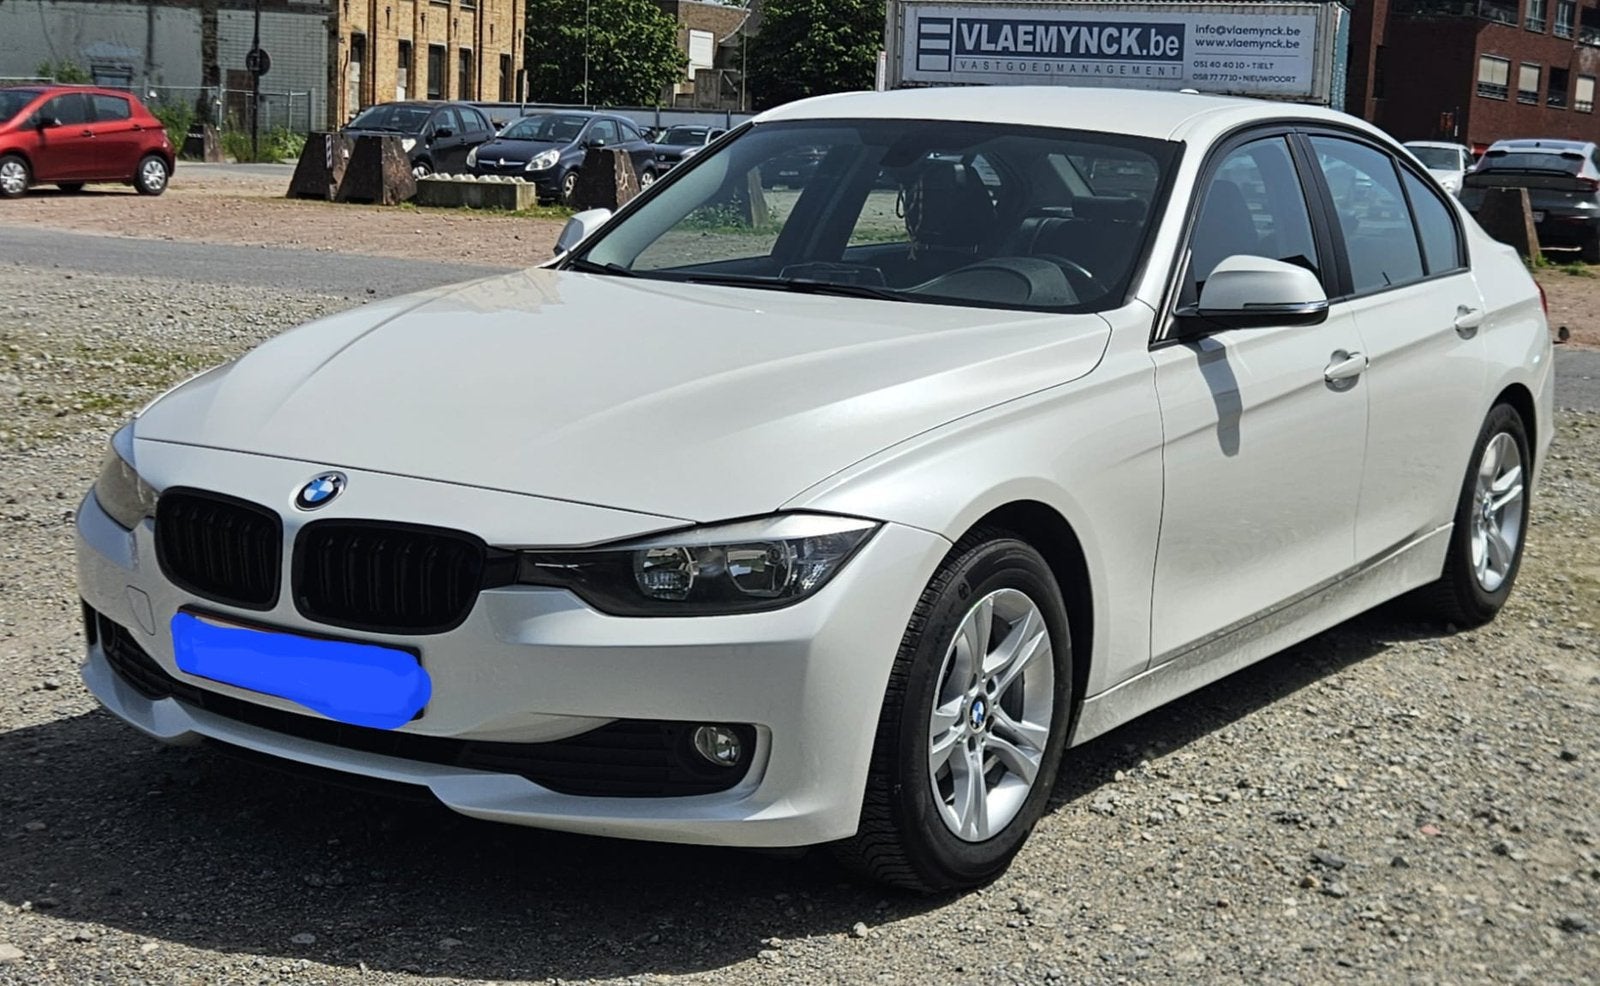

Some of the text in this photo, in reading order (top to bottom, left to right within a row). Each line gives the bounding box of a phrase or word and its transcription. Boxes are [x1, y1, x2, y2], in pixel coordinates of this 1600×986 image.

[1195, 24, 1301, 37] info@vlaemynck.be
[960, 23, 1179, 56] VLAEMYNCK.be
[1195, 38, 1300, 50] www.vlaemynck.be
[960, 61, 1178, 76] VASTGOEDMANAGEMENT
[1193, 60, 1208, 68] 051
[1209, 61, 1221, 69] 40
[1222, 61, 1234, 69] 40
[1252, 62, 1274, 70] TIELT
[1243, 75, 1296, 83] NIEUWPOORT
